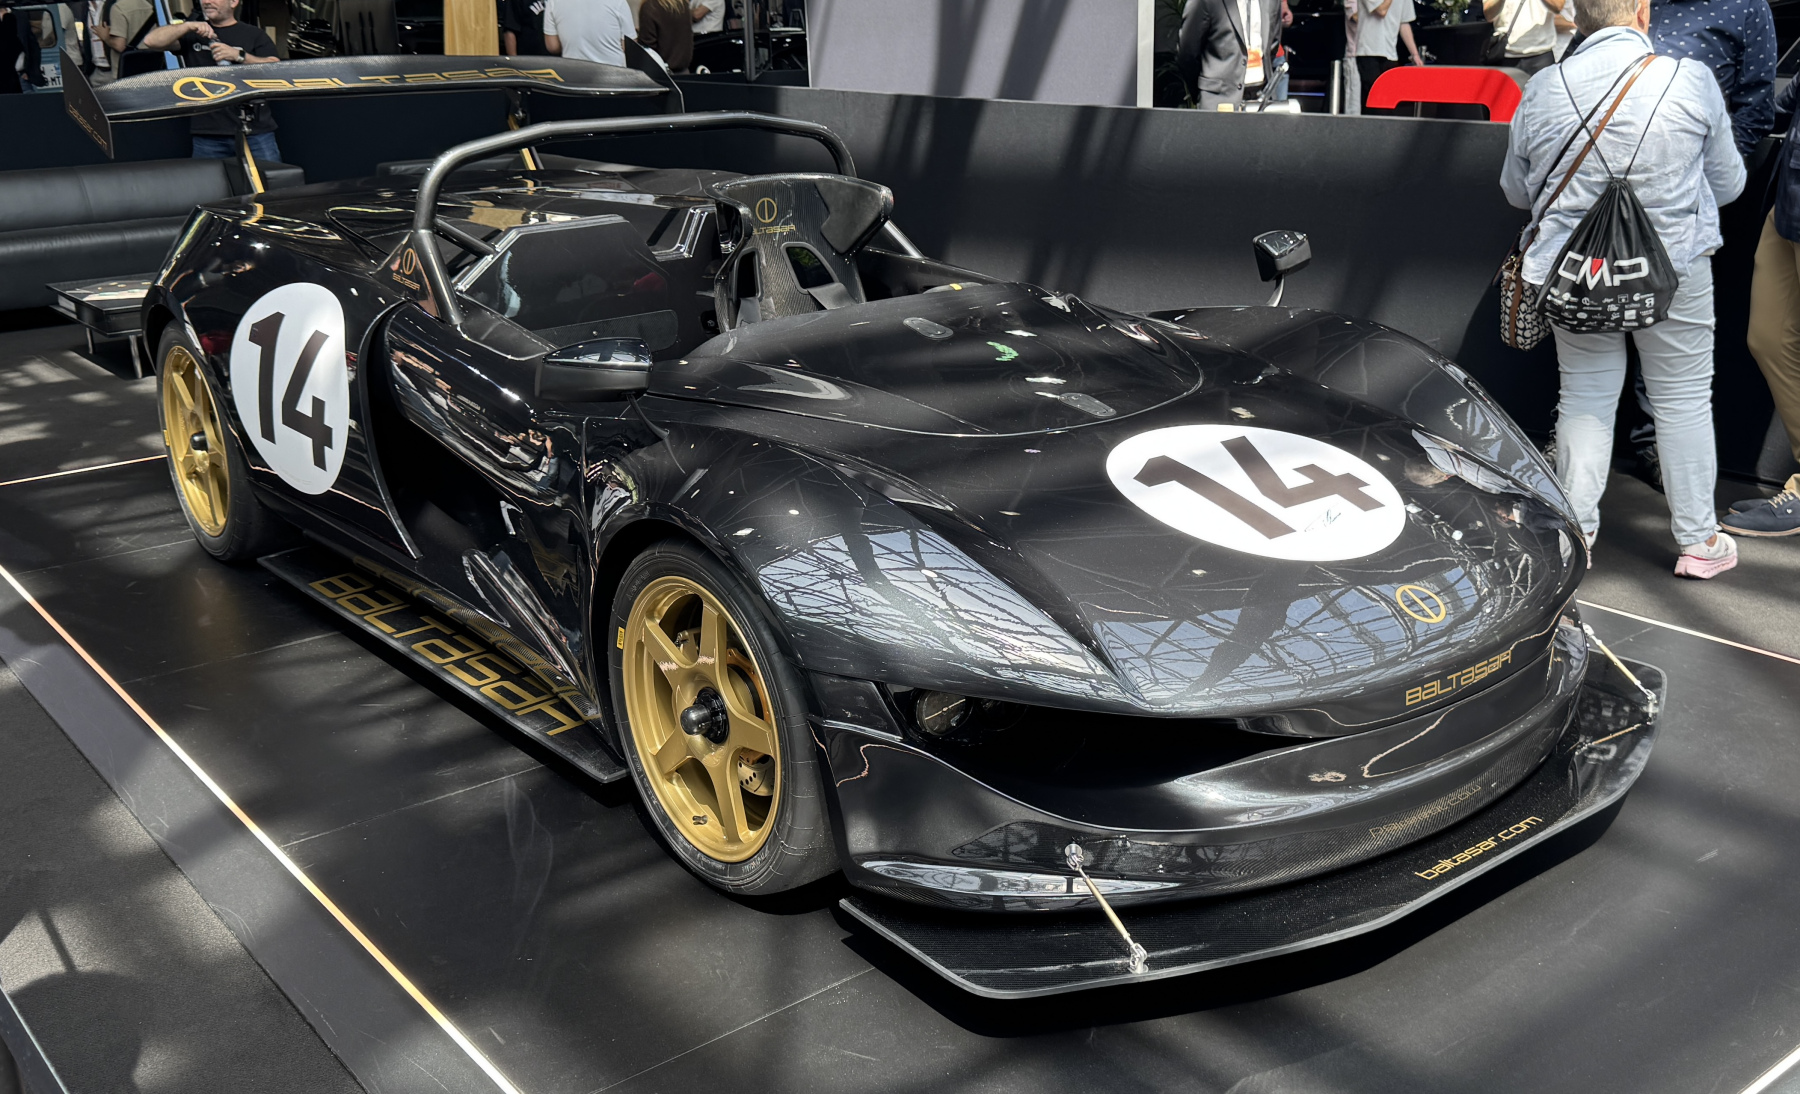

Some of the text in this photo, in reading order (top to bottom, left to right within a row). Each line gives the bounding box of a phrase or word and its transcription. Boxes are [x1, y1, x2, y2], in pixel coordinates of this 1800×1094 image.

[1558, 251, 1649, 290] CMP
[248, 311, 333, 472] 14
[1133, 436, 1386, 539] 14
[1415, 816, 1543, 880] baltasar.com
